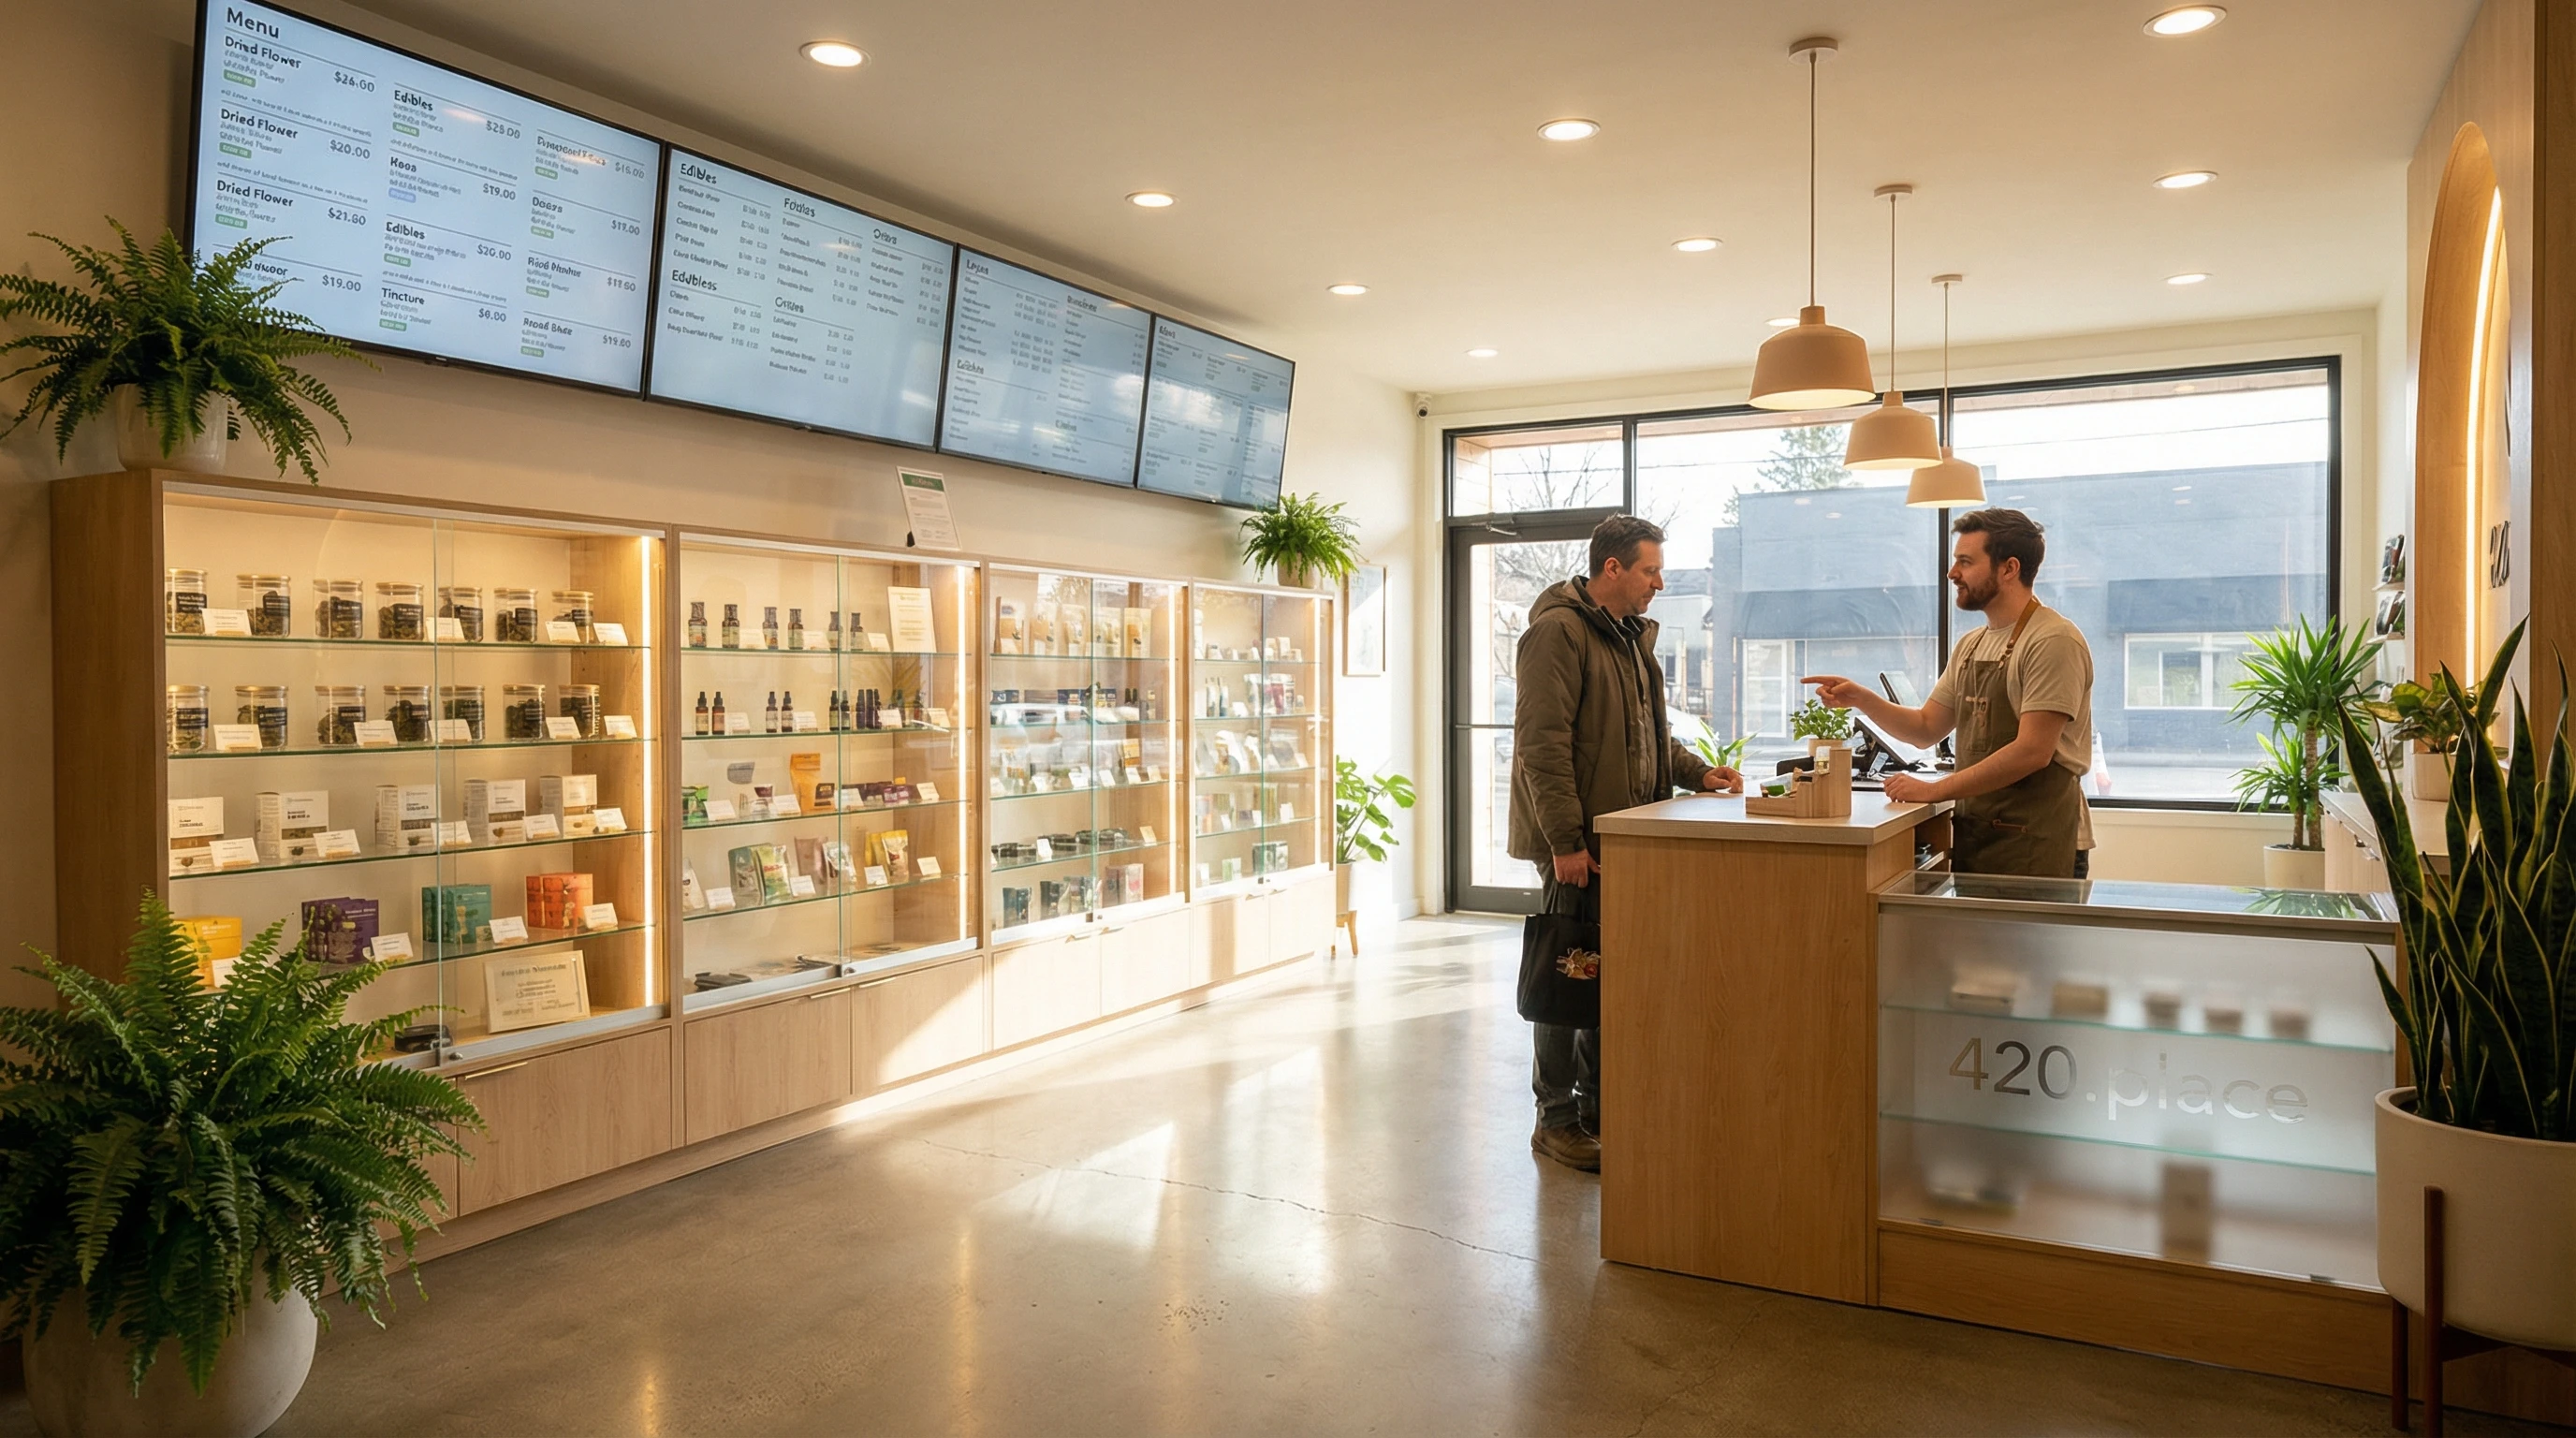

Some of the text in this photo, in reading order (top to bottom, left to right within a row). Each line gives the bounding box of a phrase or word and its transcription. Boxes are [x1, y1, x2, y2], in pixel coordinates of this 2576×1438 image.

[227, 7, 279, 38] Menu
[225, 36, 257, 55] Dried
[261, 47, 301, 68] Flower
[221, 108, 255, 126] Dried
[329, 139, 371, 159] $20.00
[217, 180, 251, 198] Dried
[255, 189, 294, 207] Flower
[381, 287, 425, 305] Tincture
[1949, 1036, 2308, 1123] 420.place
